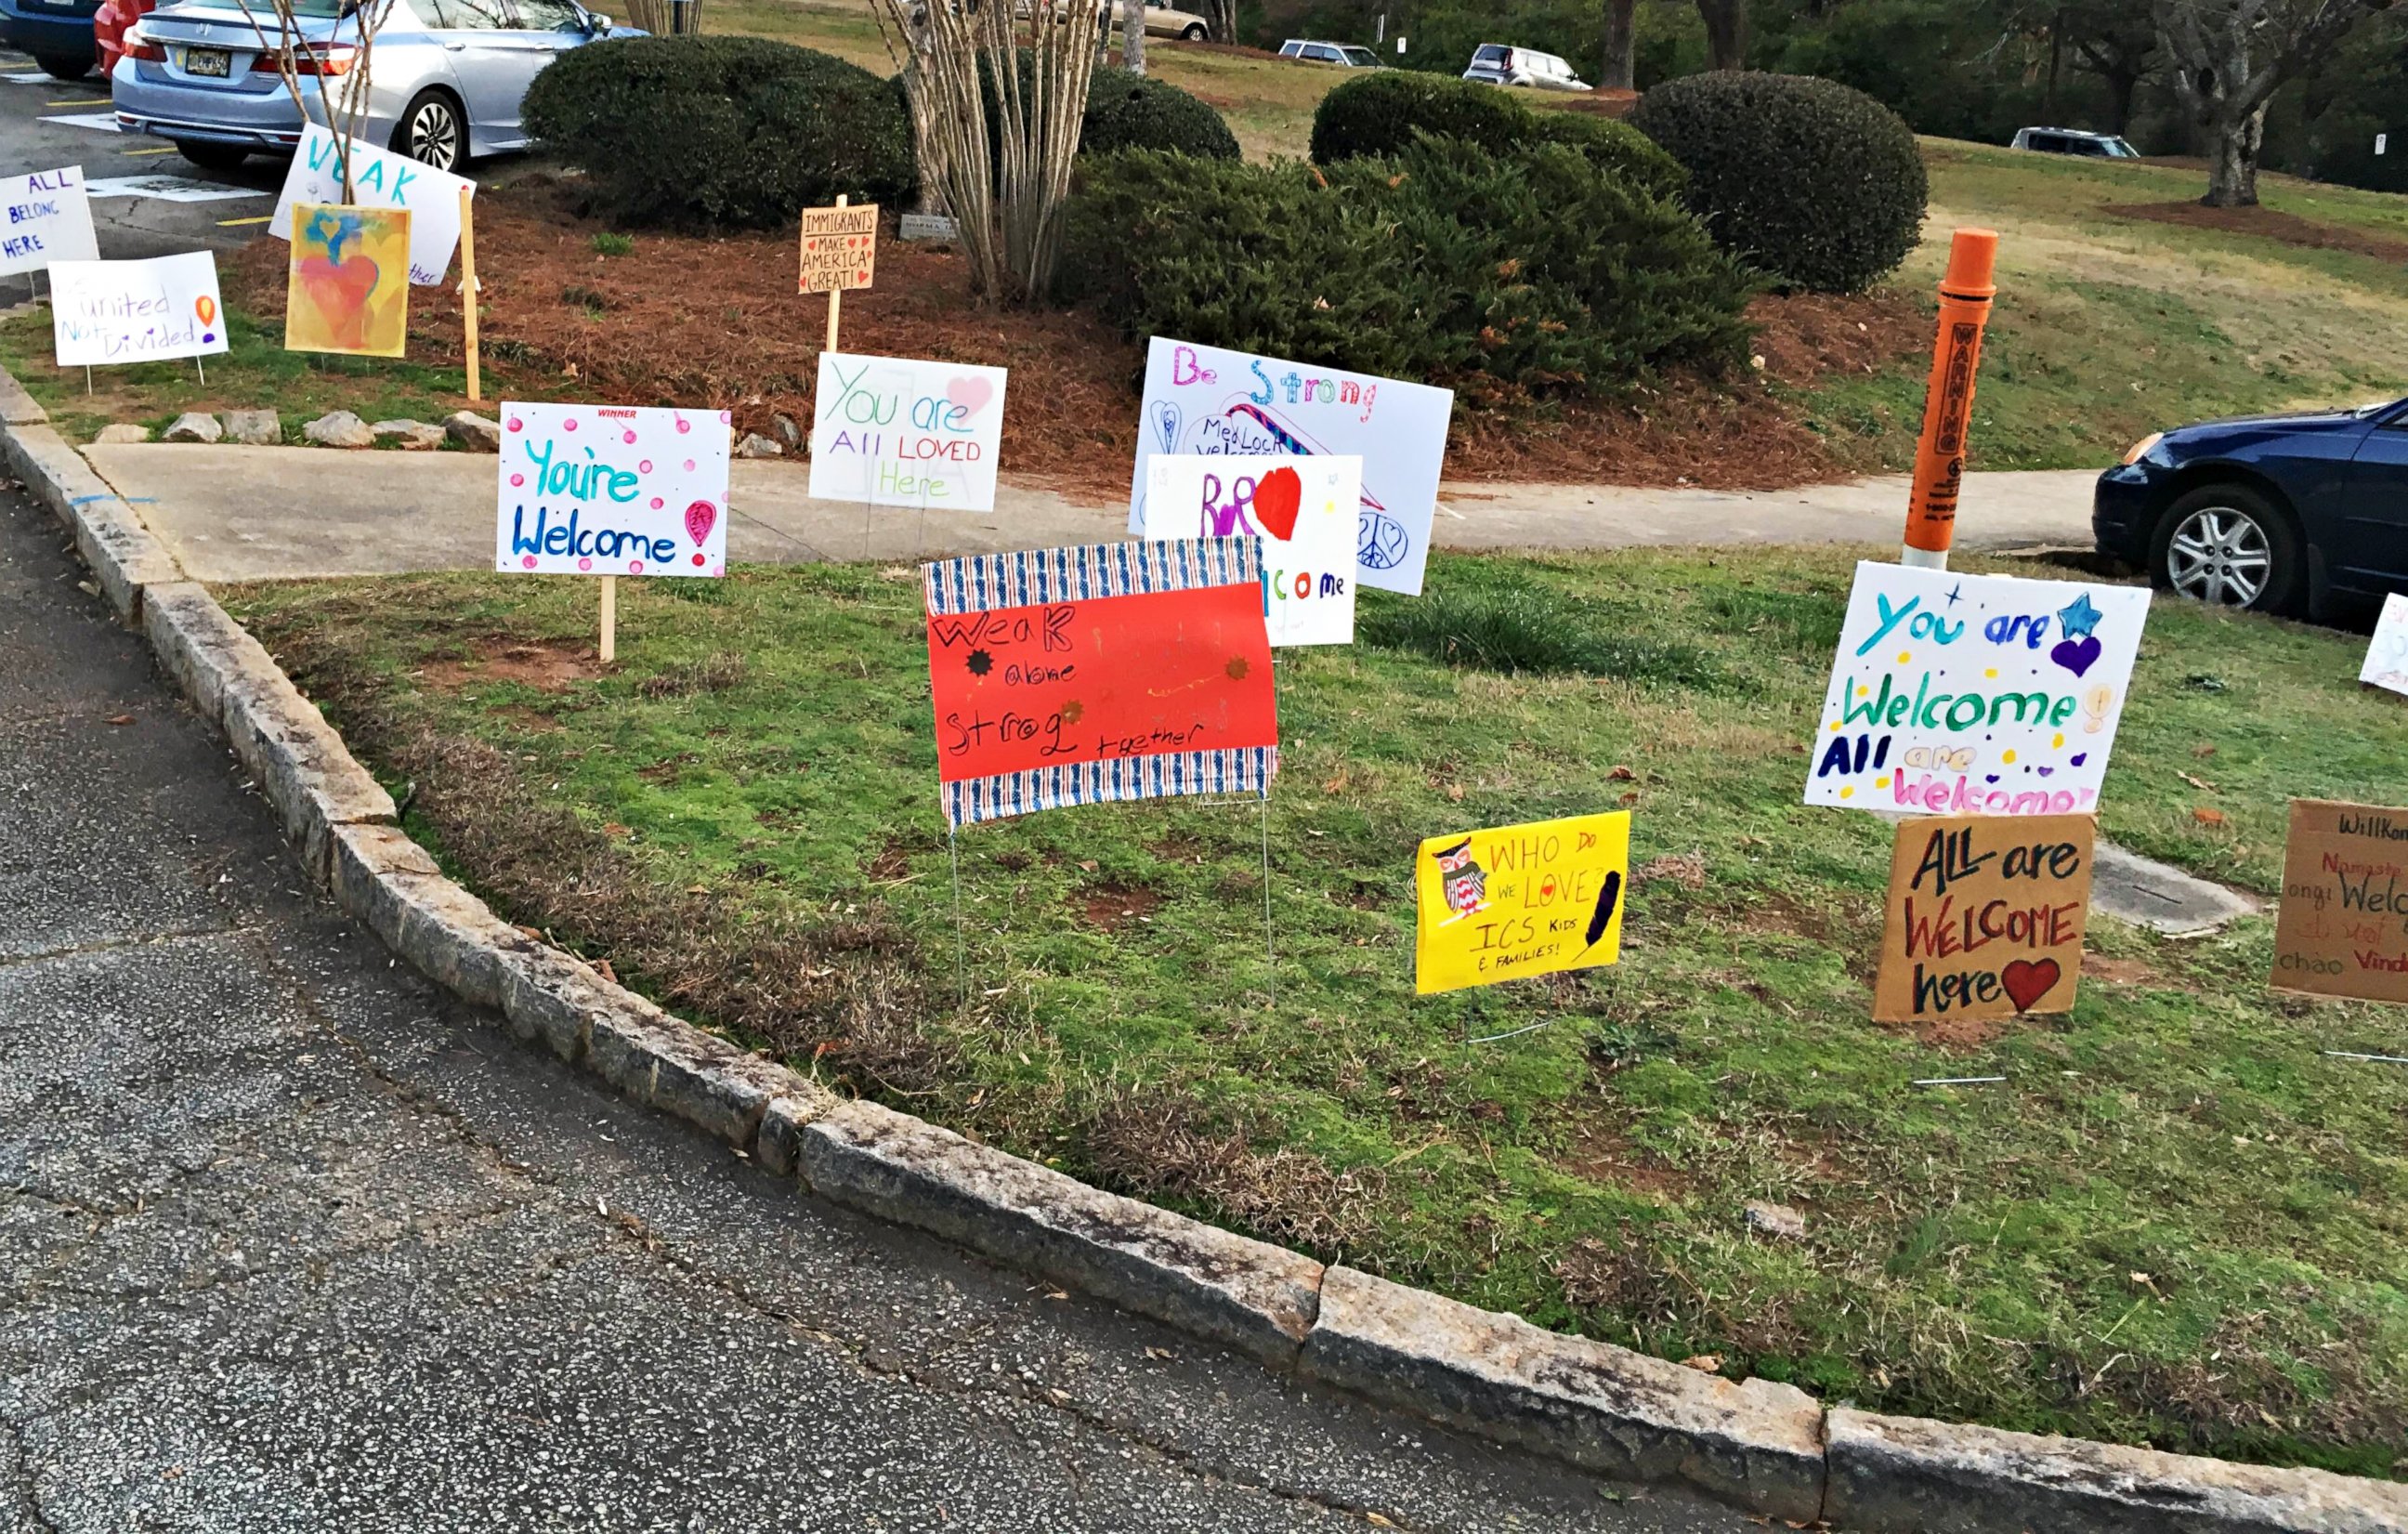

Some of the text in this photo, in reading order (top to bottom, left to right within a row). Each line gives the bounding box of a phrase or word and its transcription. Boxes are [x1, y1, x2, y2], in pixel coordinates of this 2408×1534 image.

[29, 170, 73, 193] ALL
[308, 136, 417, 205] WEAK
[805, 210, 873, 232] IMMIGRANTS
[2, 235, 44, 258] HERE
[802, 251, 867, 271] AMERICA
[818, 236, 845, 252] MAKE
[808, 270, 854, 292] GREAT!
[62, 321, 107, 342] Not
[825, 361, 974, 432] You are
[1173, 346, 1377, 423] Be Strong
[1940, 326, 1975, 452] WARNING
[597, 409, 637, 419] WINNER
[830, 430, 980, 461] All LOVED
[525, 439, 640, 502] You're
[880, 461, 950, 497] Here
[1856, 593, 2050, 657] You are
[1005, 660, 1077, 686] alone
[1817, 734, 1977, 777] All are
[1490, 836, 1560, 873] WHO
[2002, 843, 2080, 879] are
[1498, 885, 1516, 900] WE
[1470, 916, 1535, 952] ICS
[1905, 895, 2080, 959] WELCOME
[1496, 943, 1560, 969] FAMILIES!
[1913, 964, 2002, 1015] here
